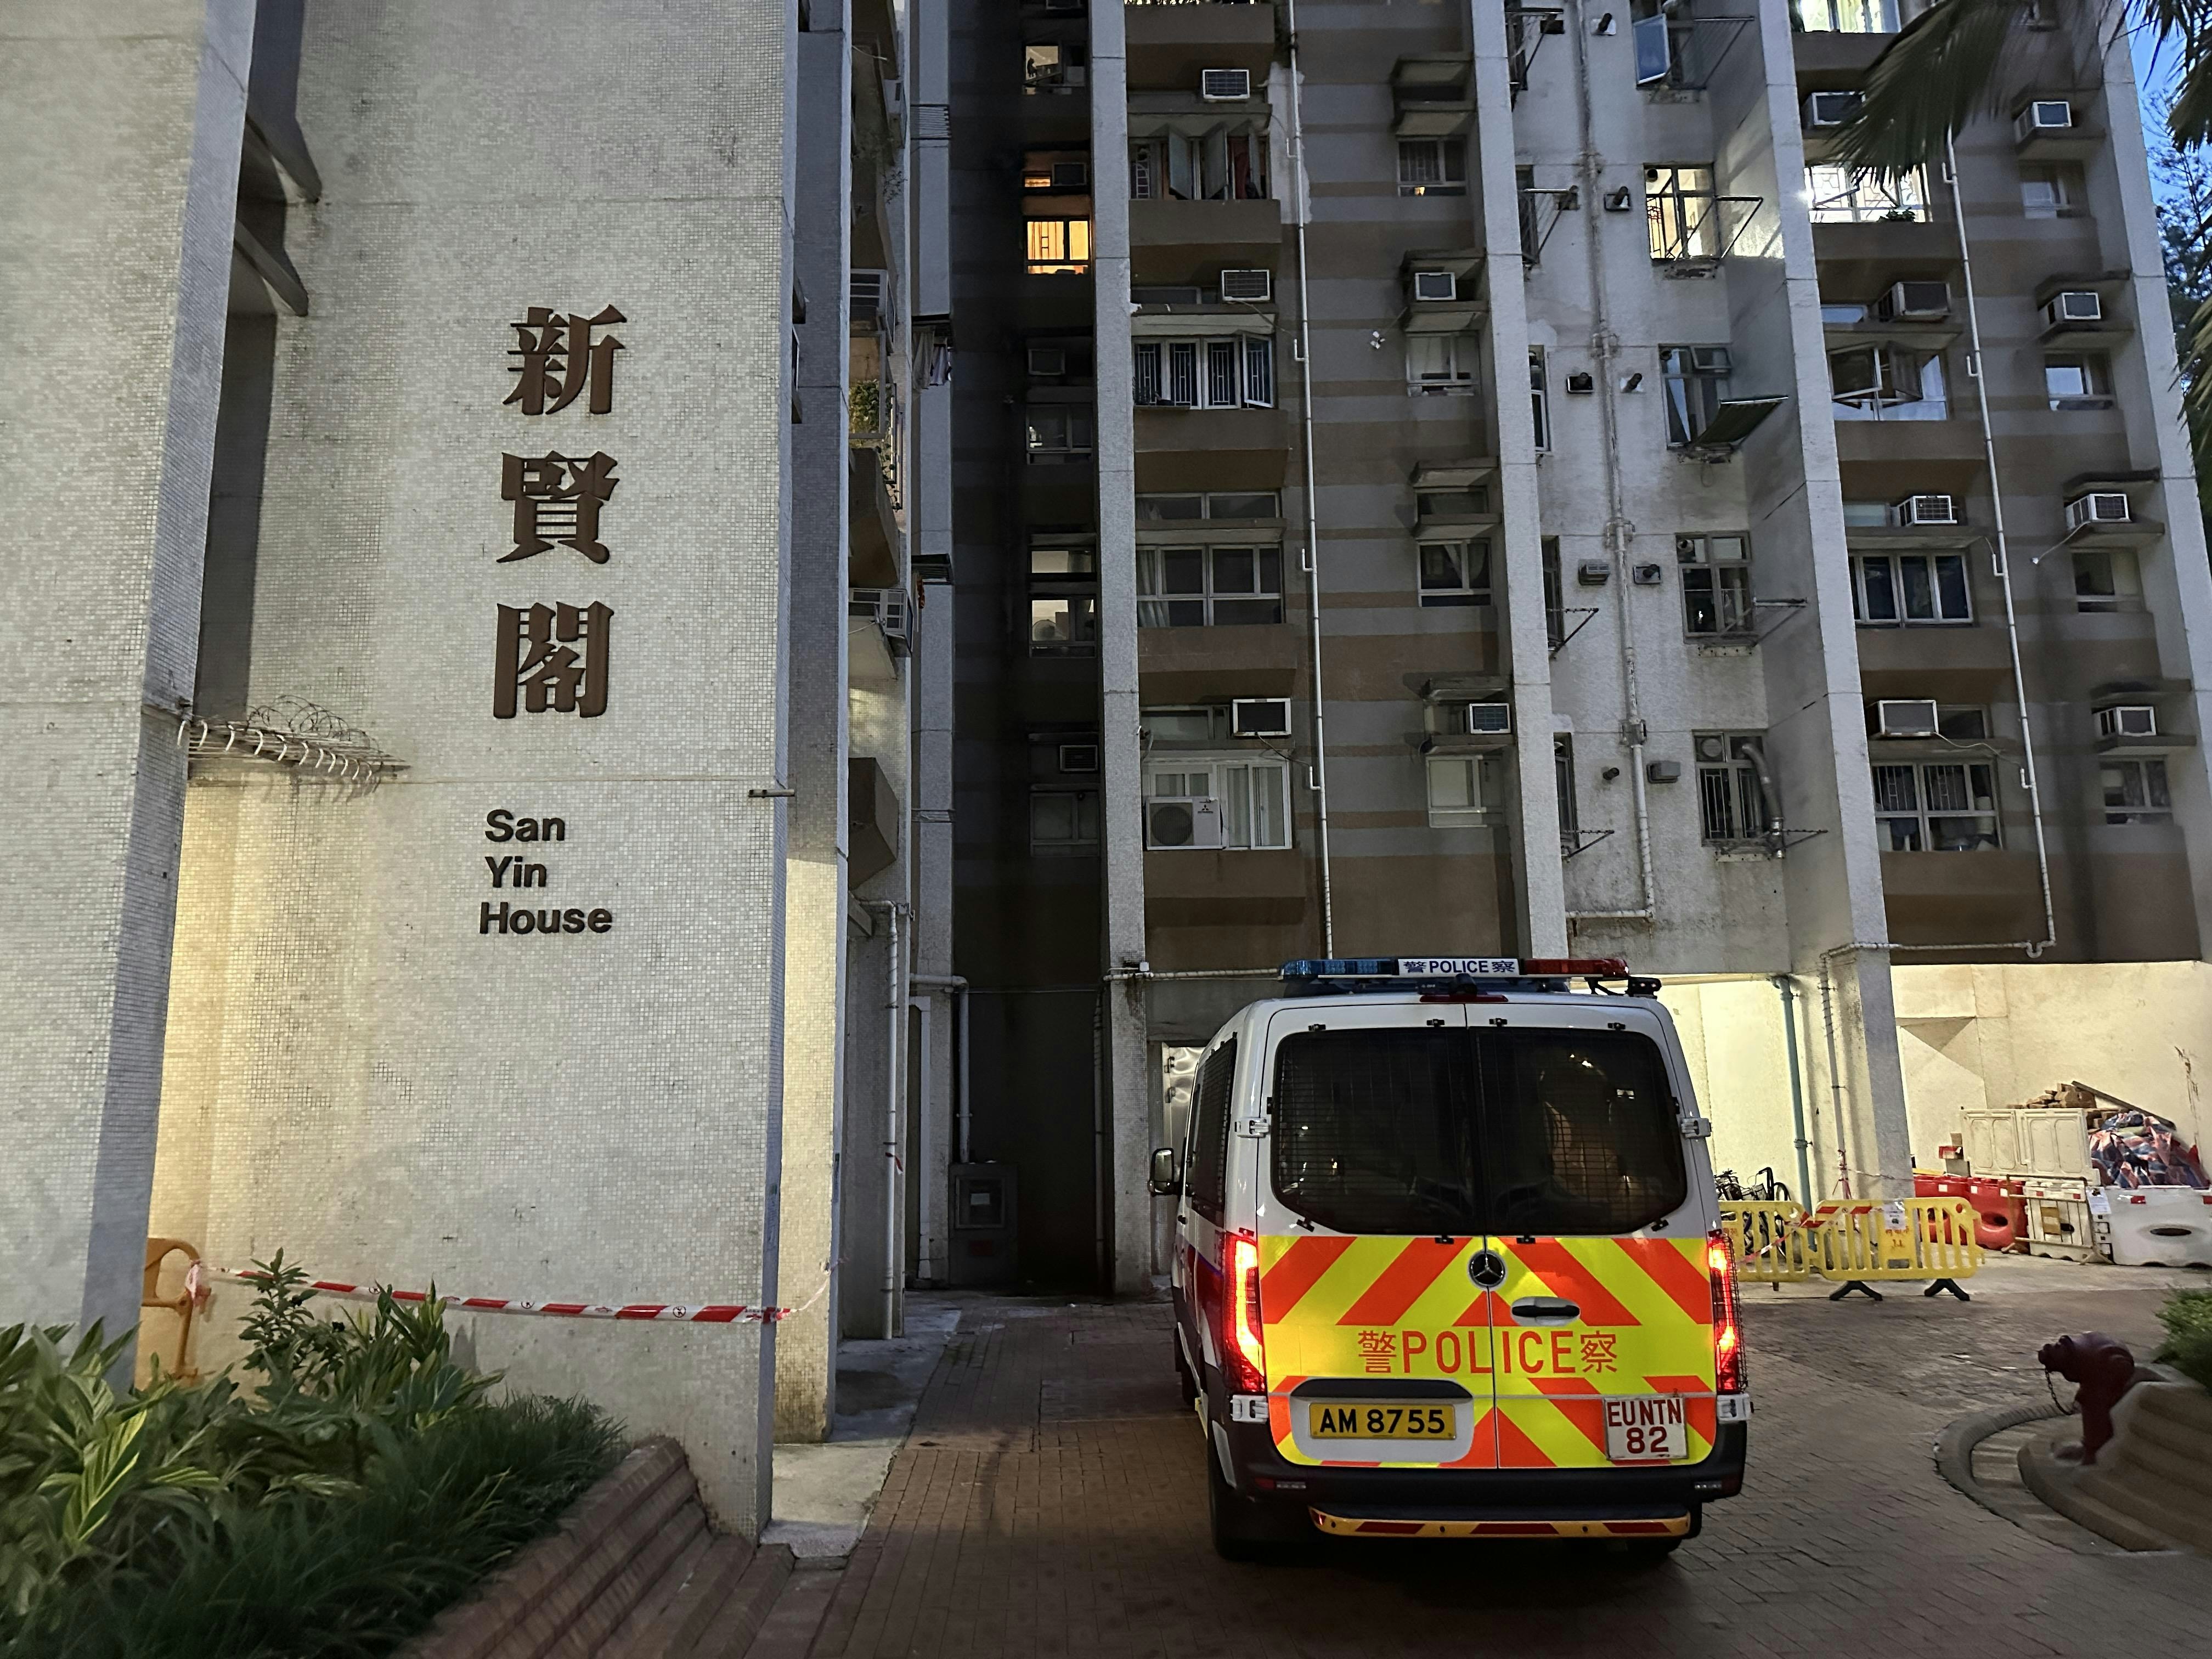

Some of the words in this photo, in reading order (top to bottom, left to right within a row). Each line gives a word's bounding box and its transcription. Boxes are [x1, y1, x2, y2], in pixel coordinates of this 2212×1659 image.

[493, 304, 627, 719] 新賢閣
[485, 809, 566, 842] San
[484, 855, 547, 888] Yin
[479, 901, 613, 934] House
[1319, 1408, 1357, 1433] AM
[1367, 1409, 1445, 1434] 8755
[1626, 1426, 1669, 1454] 82
